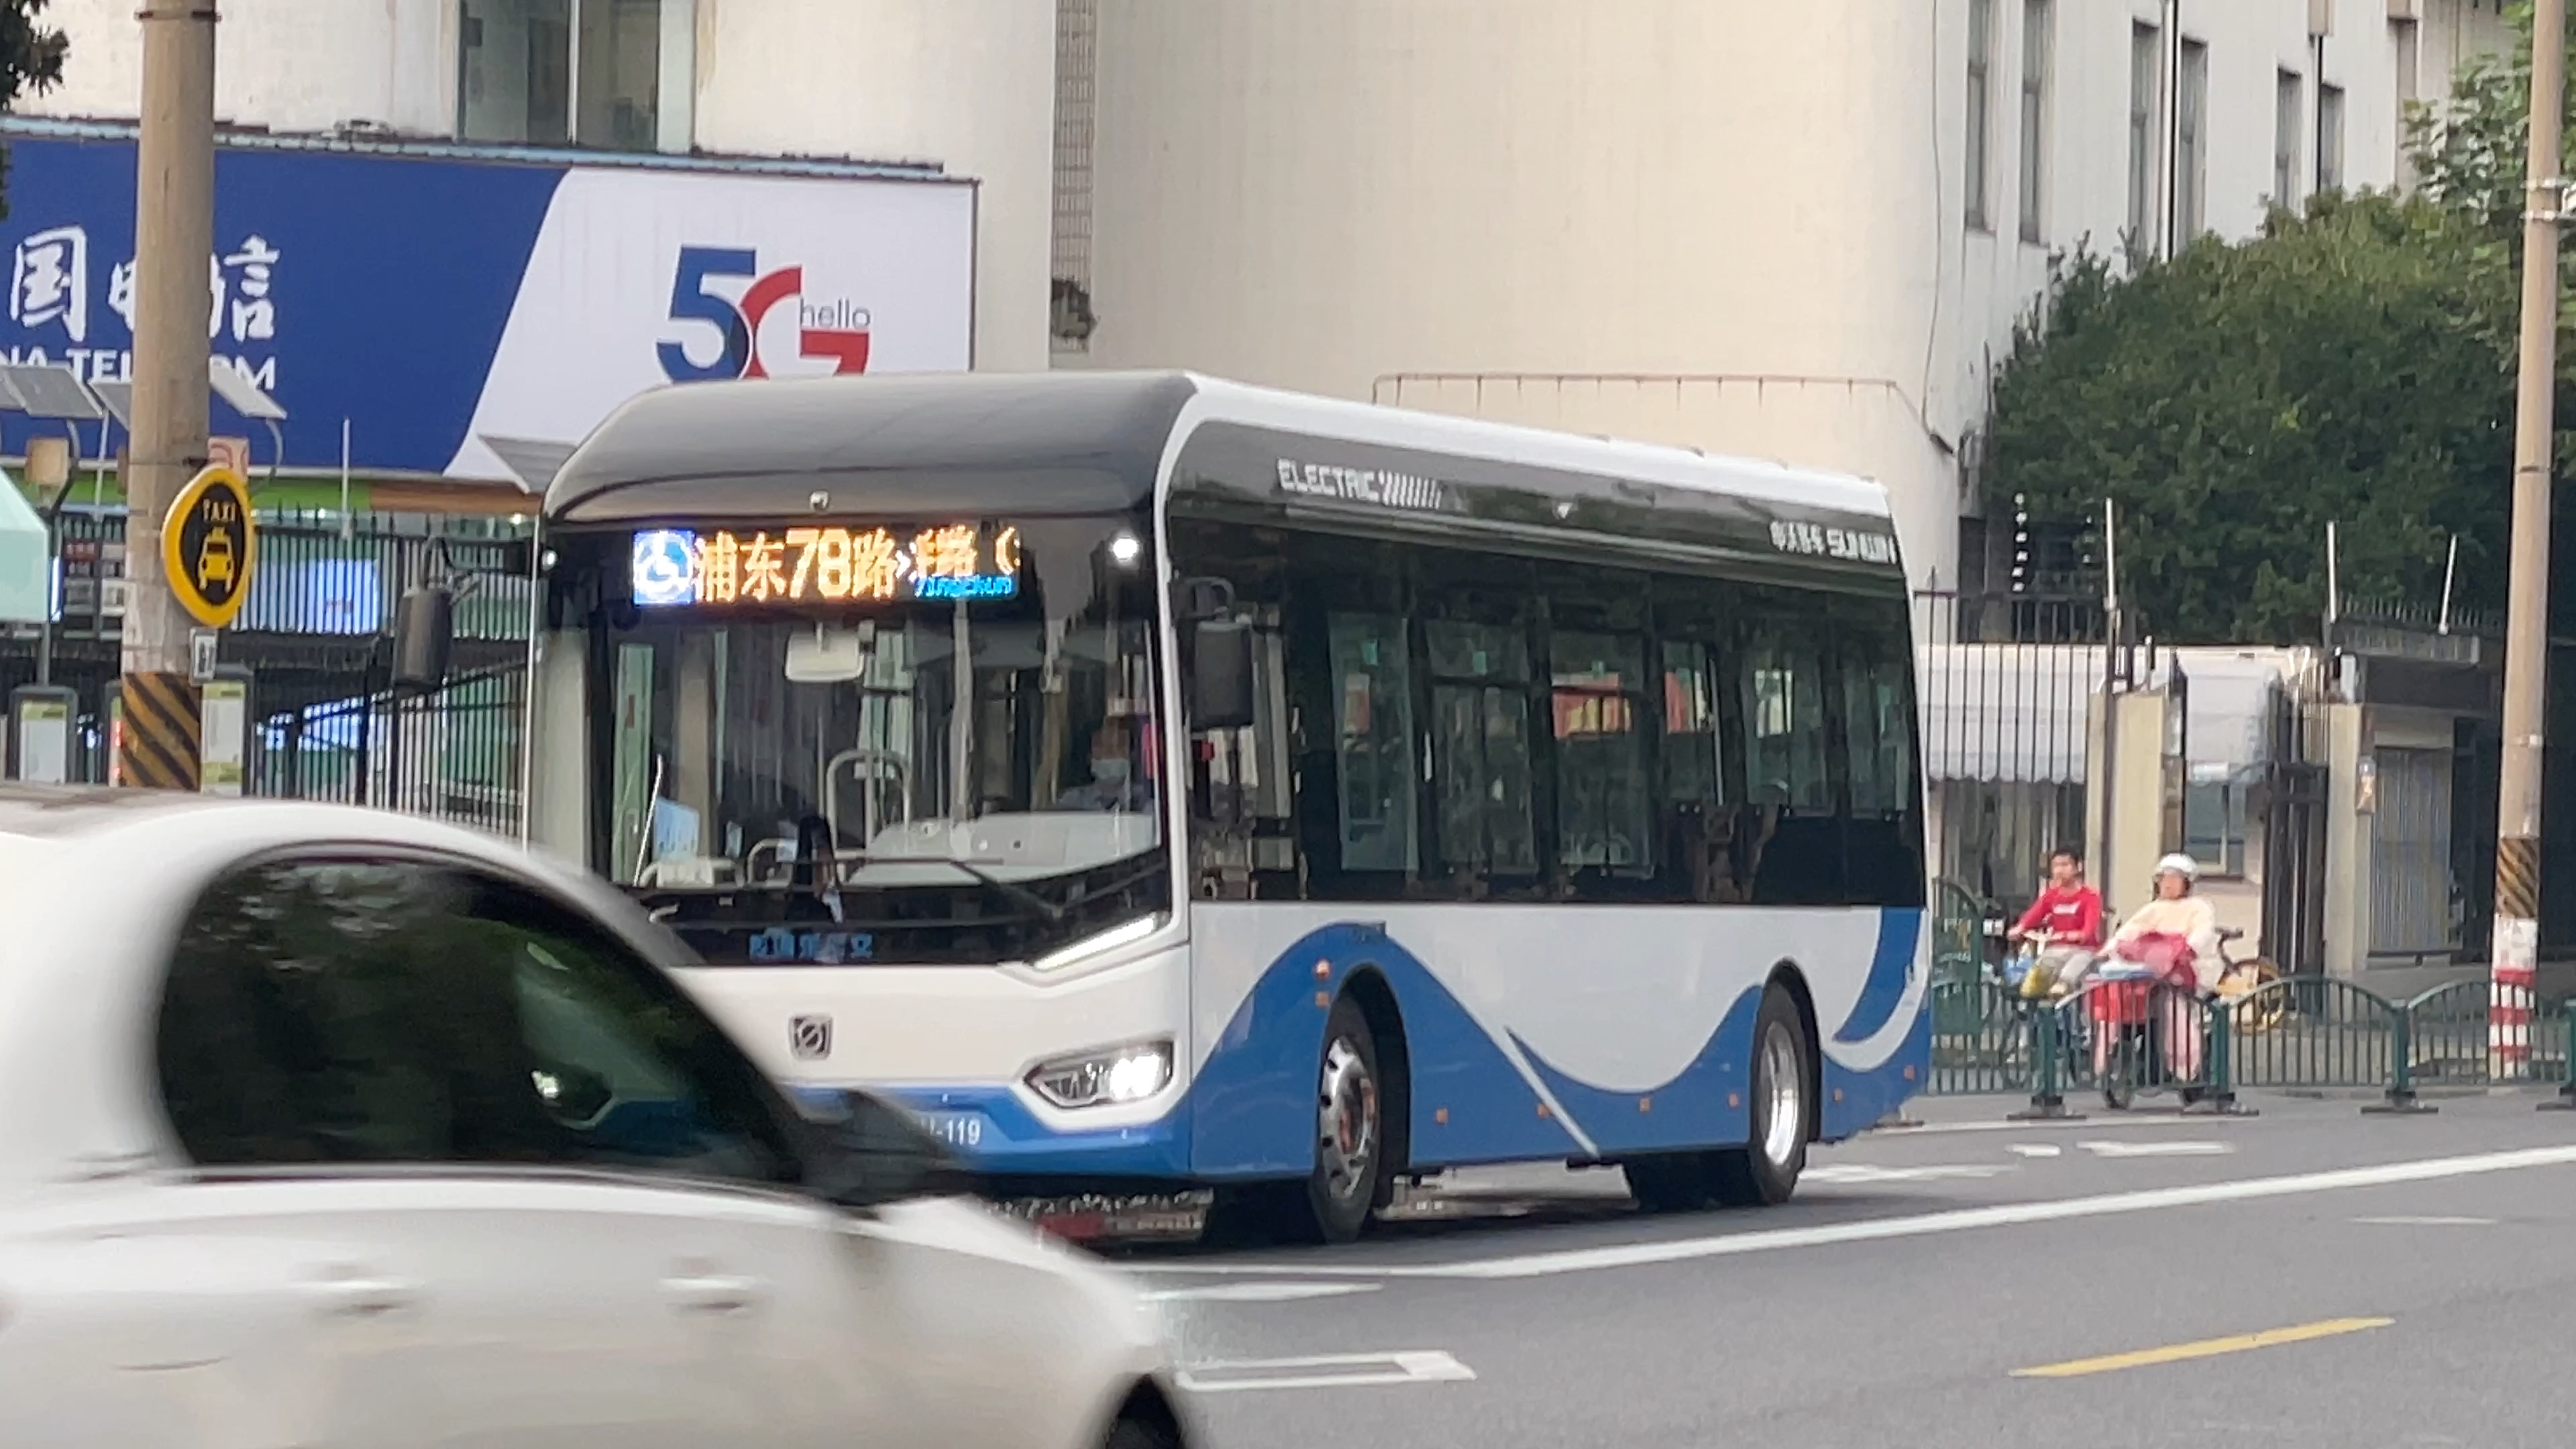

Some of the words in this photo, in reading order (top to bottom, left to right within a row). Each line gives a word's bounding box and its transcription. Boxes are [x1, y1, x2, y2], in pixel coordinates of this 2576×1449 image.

[655, 246, 870, 382] 5G
[800, 298, 871, 329] hello
[1277, 457, 1379, 502] ELECTRIC
[203, 499, 235, 522] TAXI
